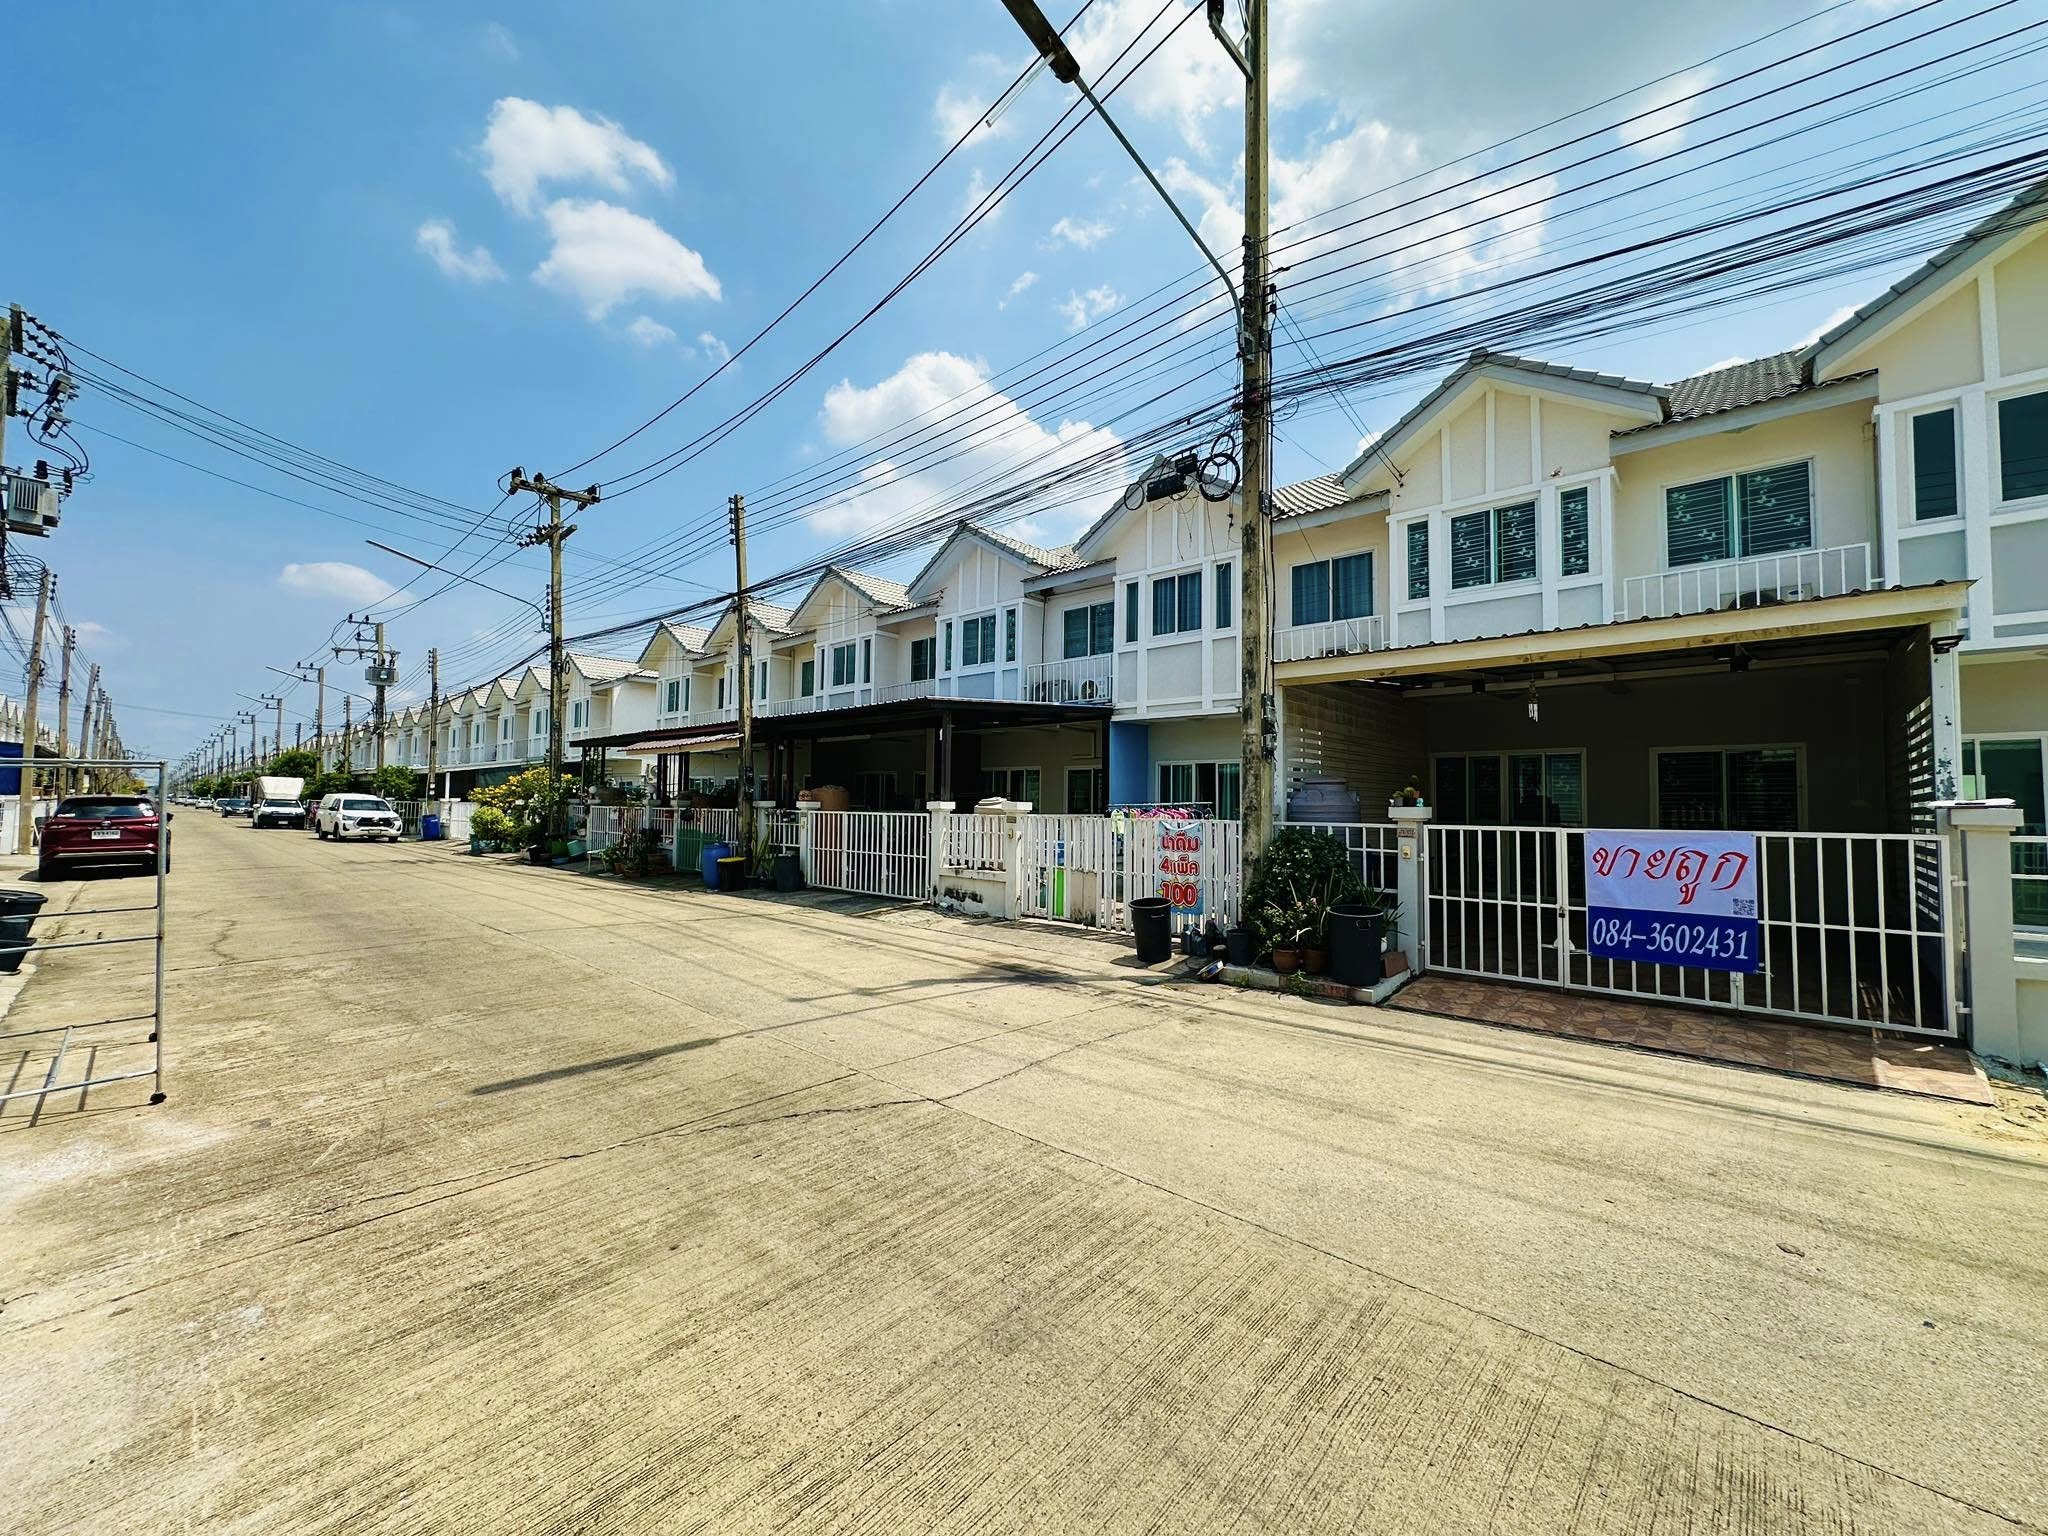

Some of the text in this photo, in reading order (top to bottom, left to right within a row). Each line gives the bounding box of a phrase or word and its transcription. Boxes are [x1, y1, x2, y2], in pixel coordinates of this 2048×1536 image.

[1161, 881, 1197, 907] 100
[1592, 845, 1749, 905] ขายถูก
[1592, 918, 1749, 960] 084-3602431
